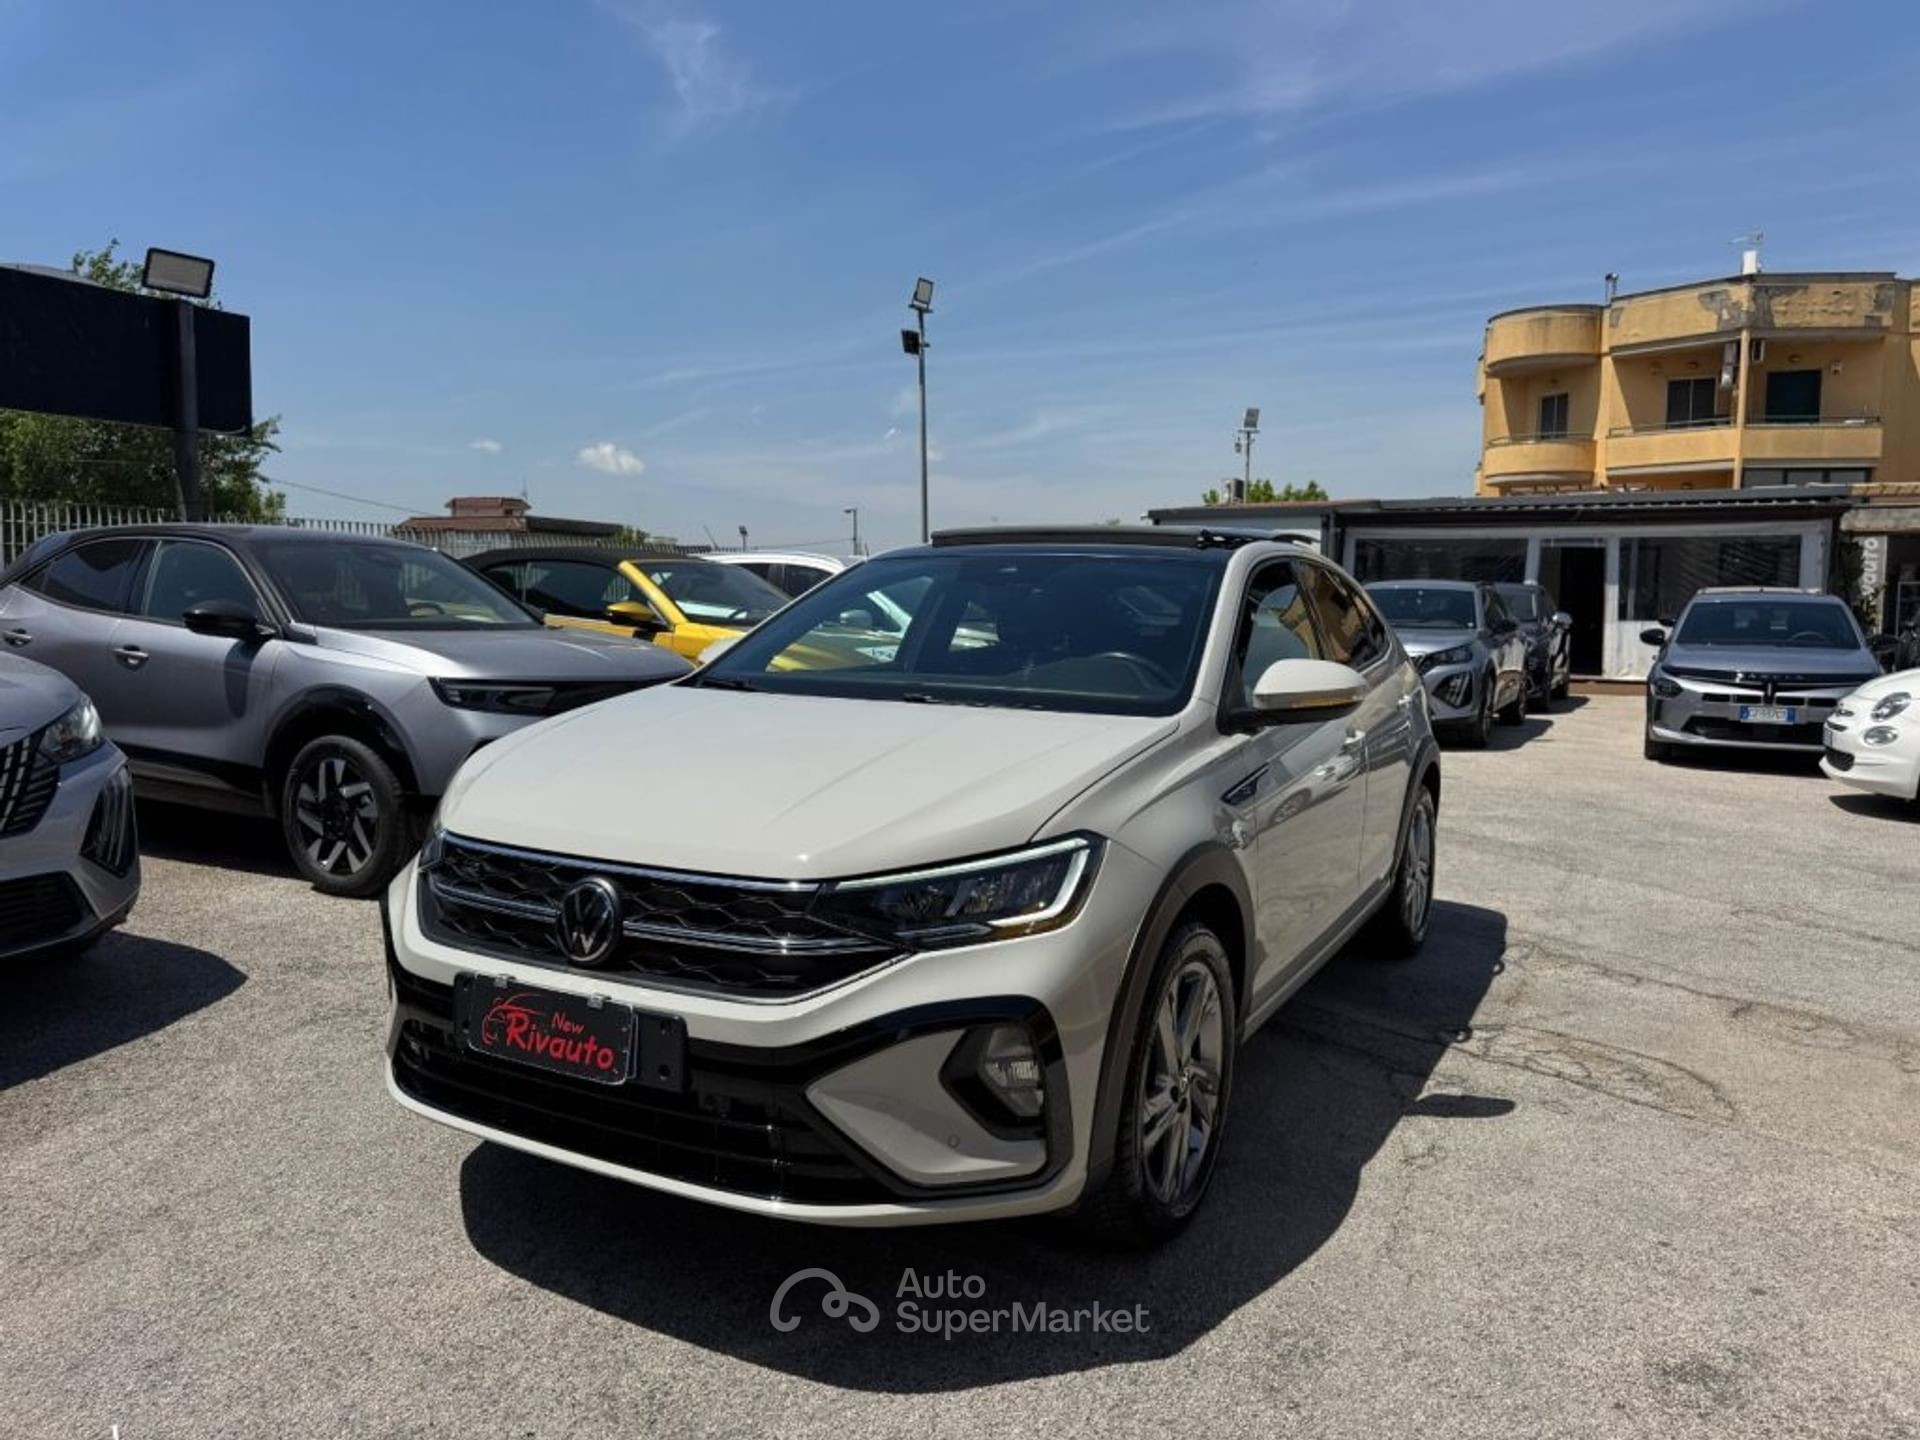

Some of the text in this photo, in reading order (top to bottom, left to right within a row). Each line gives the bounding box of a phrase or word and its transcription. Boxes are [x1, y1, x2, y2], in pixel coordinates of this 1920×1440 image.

[1861, 537, 1879, 606] vauto
[505, 1010, 615, 1070] Rivauto
[551, 1012, 585, 1034] New
